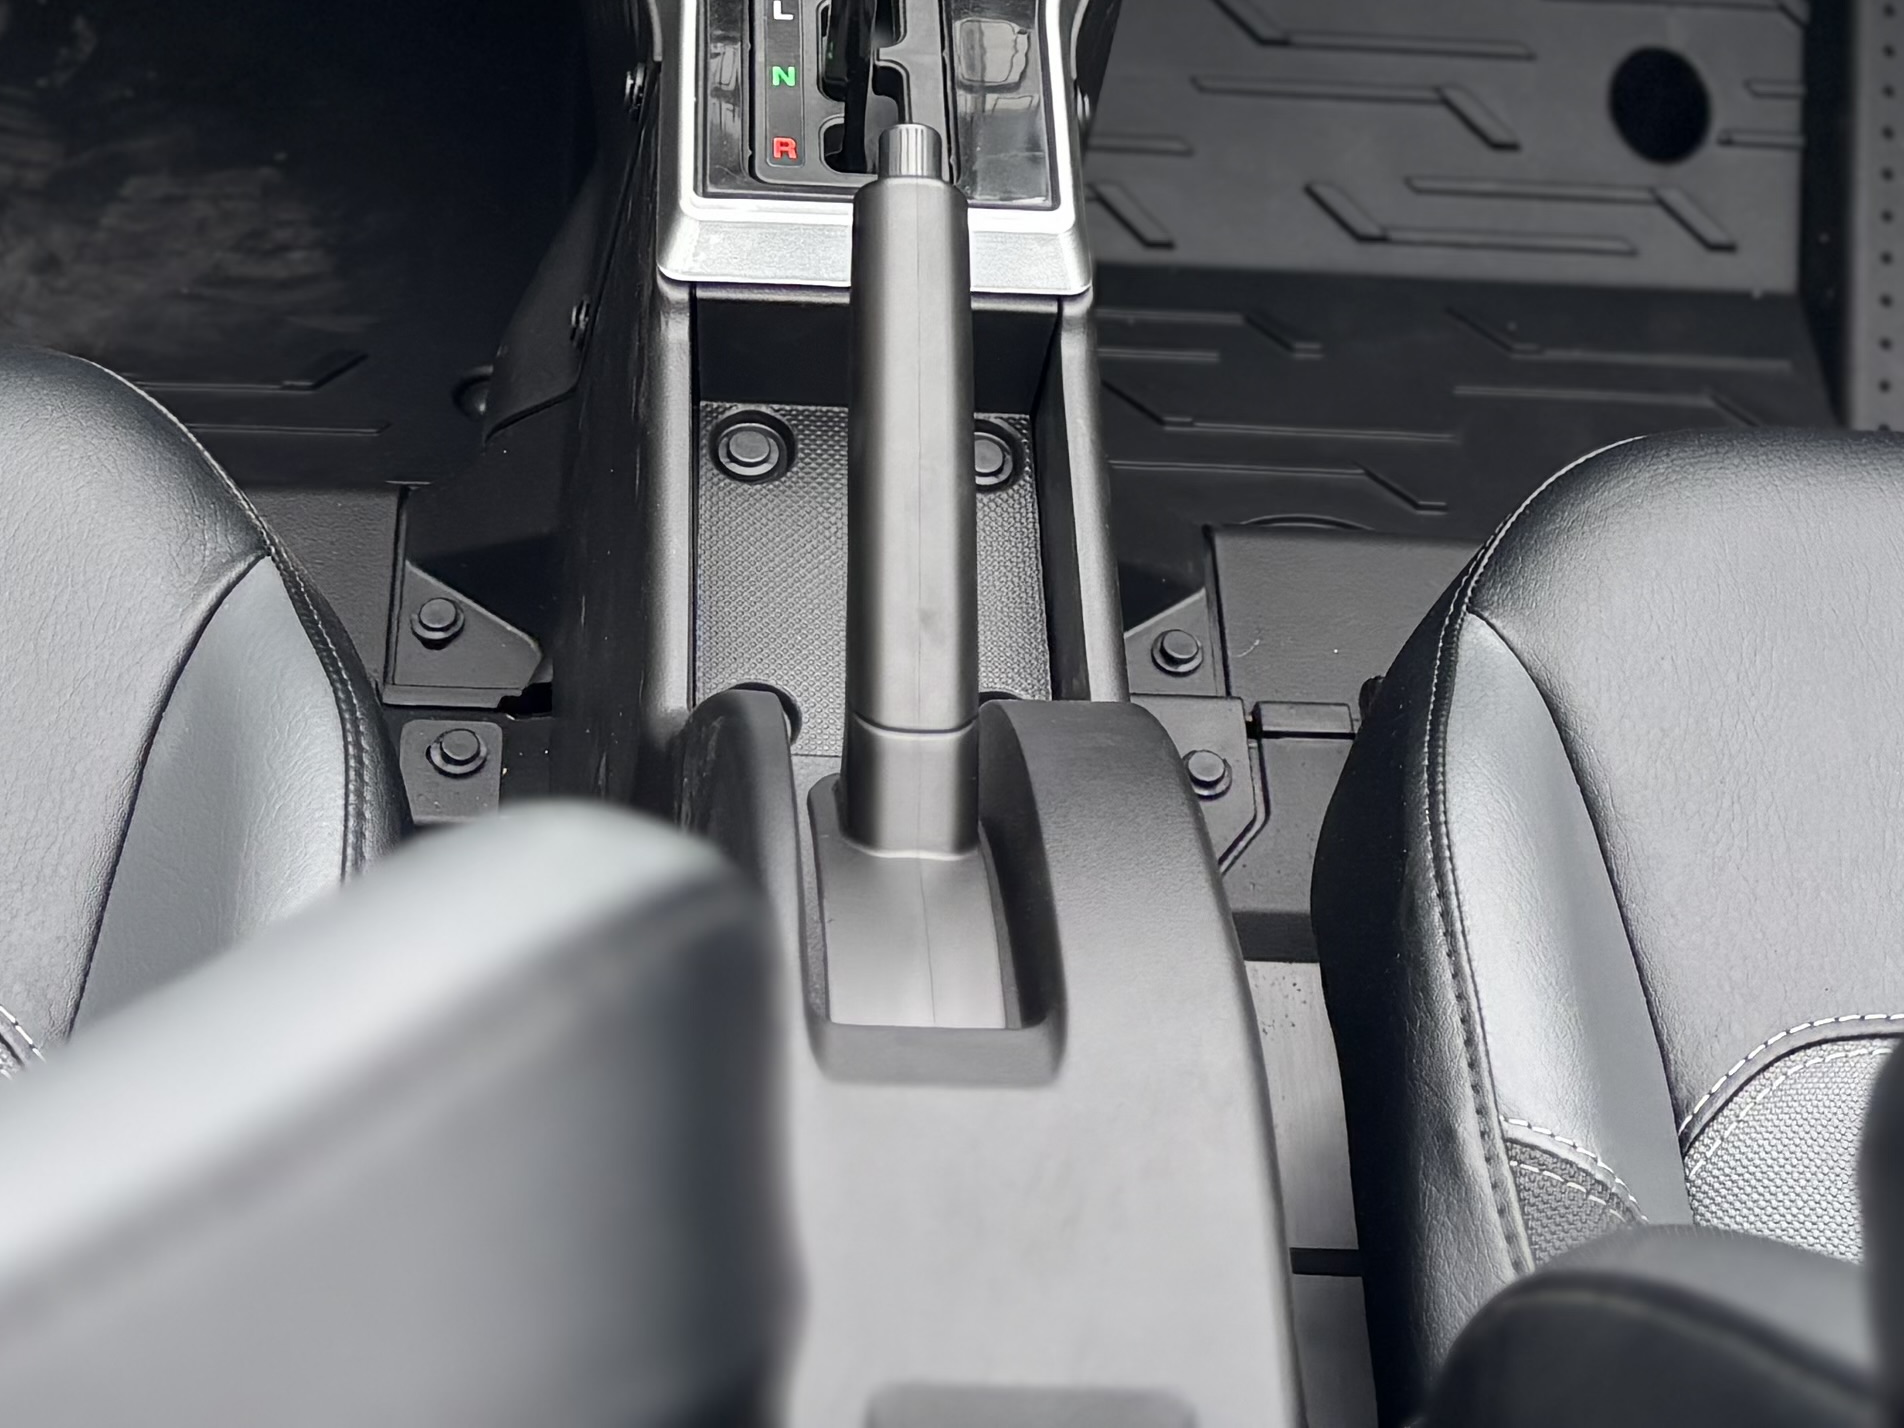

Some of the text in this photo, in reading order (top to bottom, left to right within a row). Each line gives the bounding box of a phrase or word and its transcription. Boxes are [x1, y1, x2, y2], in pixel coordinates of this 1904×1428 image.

[772, 0, 794, 21] L
[771, 66, 796, 87] N
[772, 137, 798, 159] R
